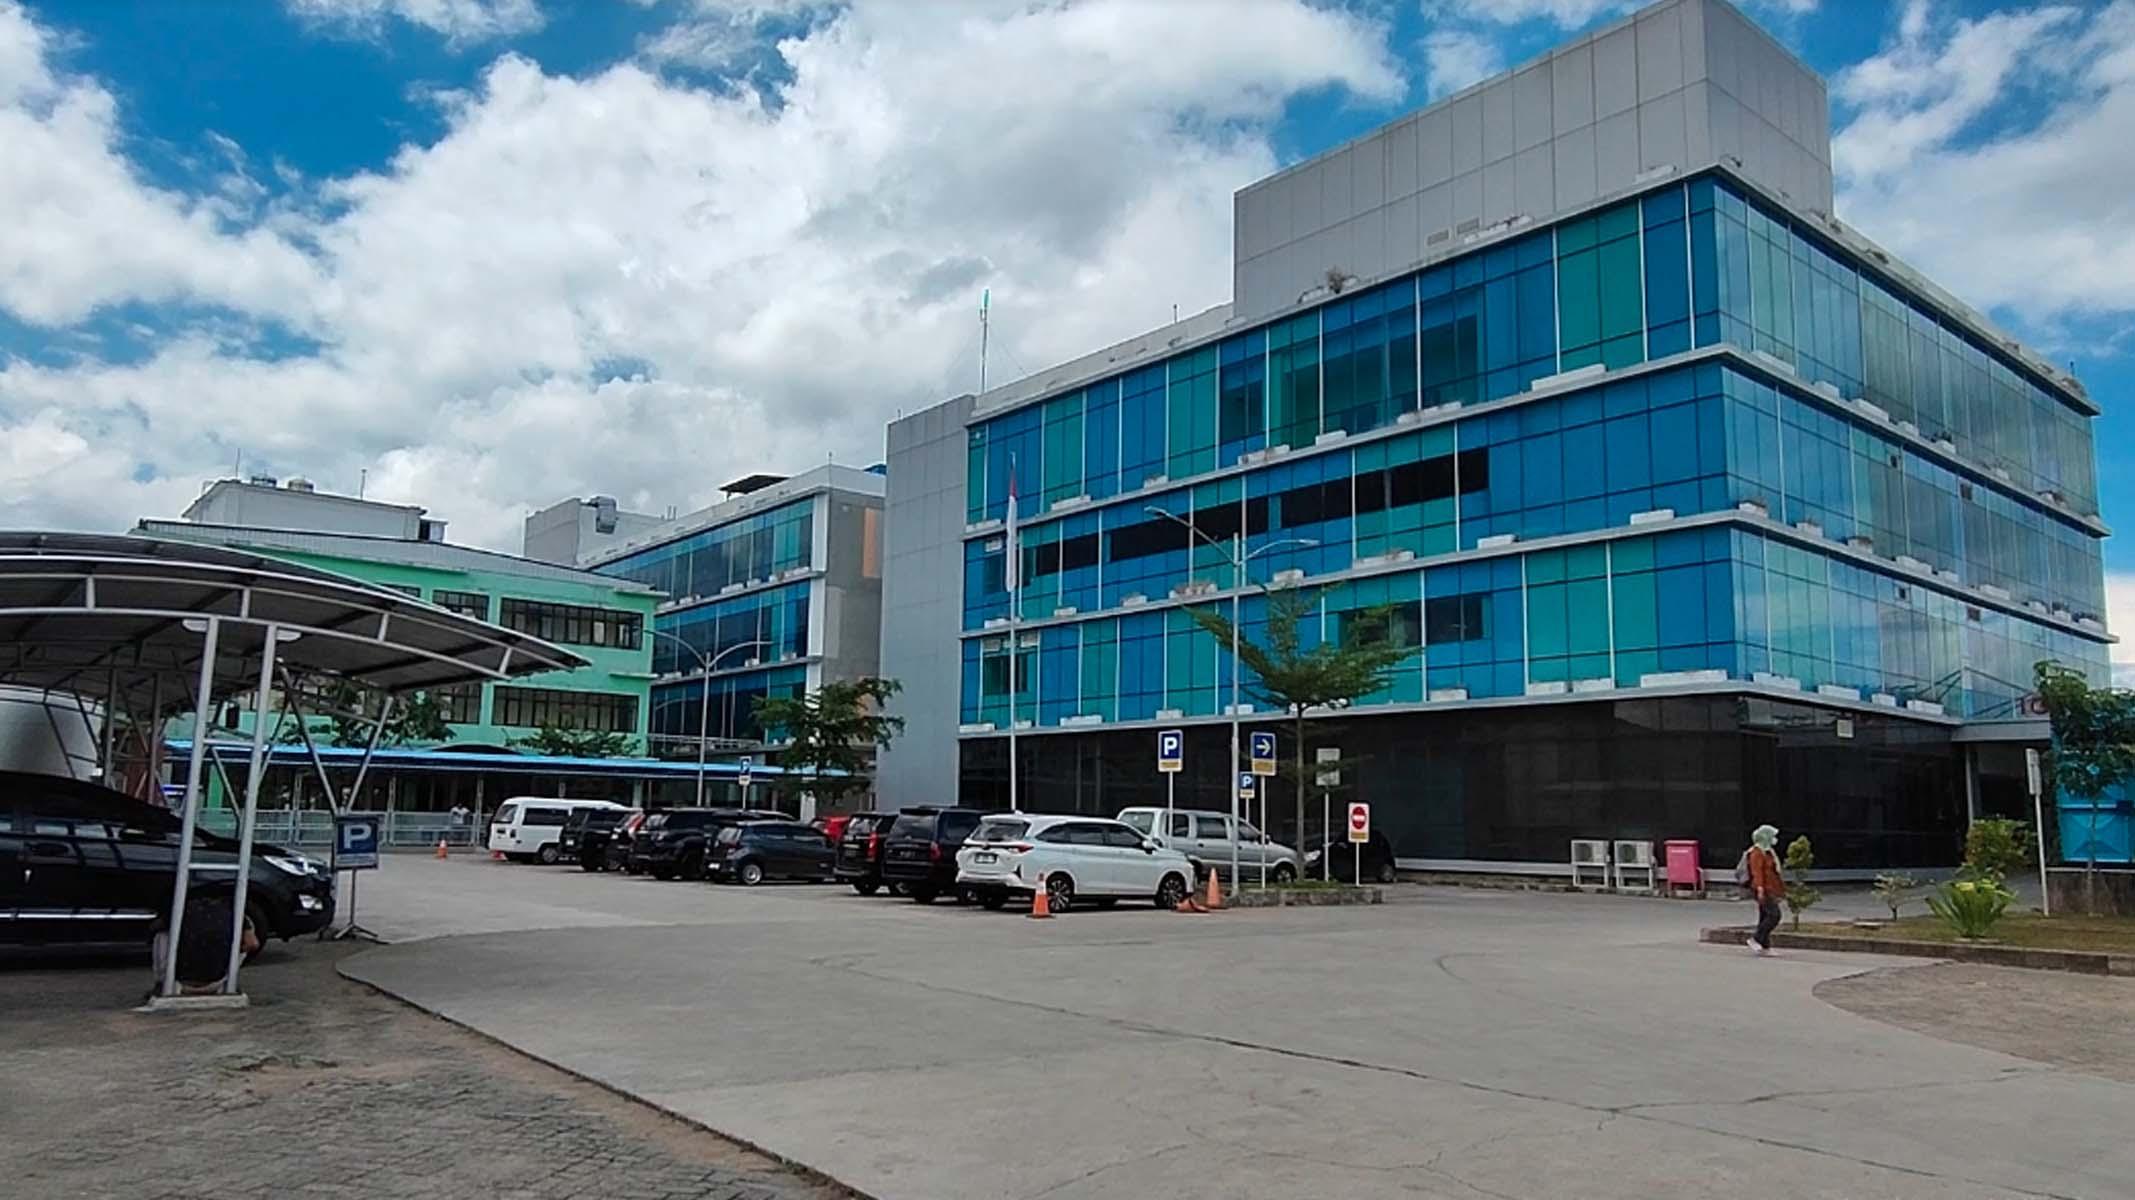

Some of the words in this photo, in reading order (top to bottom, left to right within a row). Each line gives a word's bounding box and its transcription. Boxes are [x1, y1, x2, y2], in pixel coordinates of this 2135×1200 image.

[1164, 736, 1178, 756] P
[1243, 775, 1253, 788] P
[344, 824, 371, 849] P
